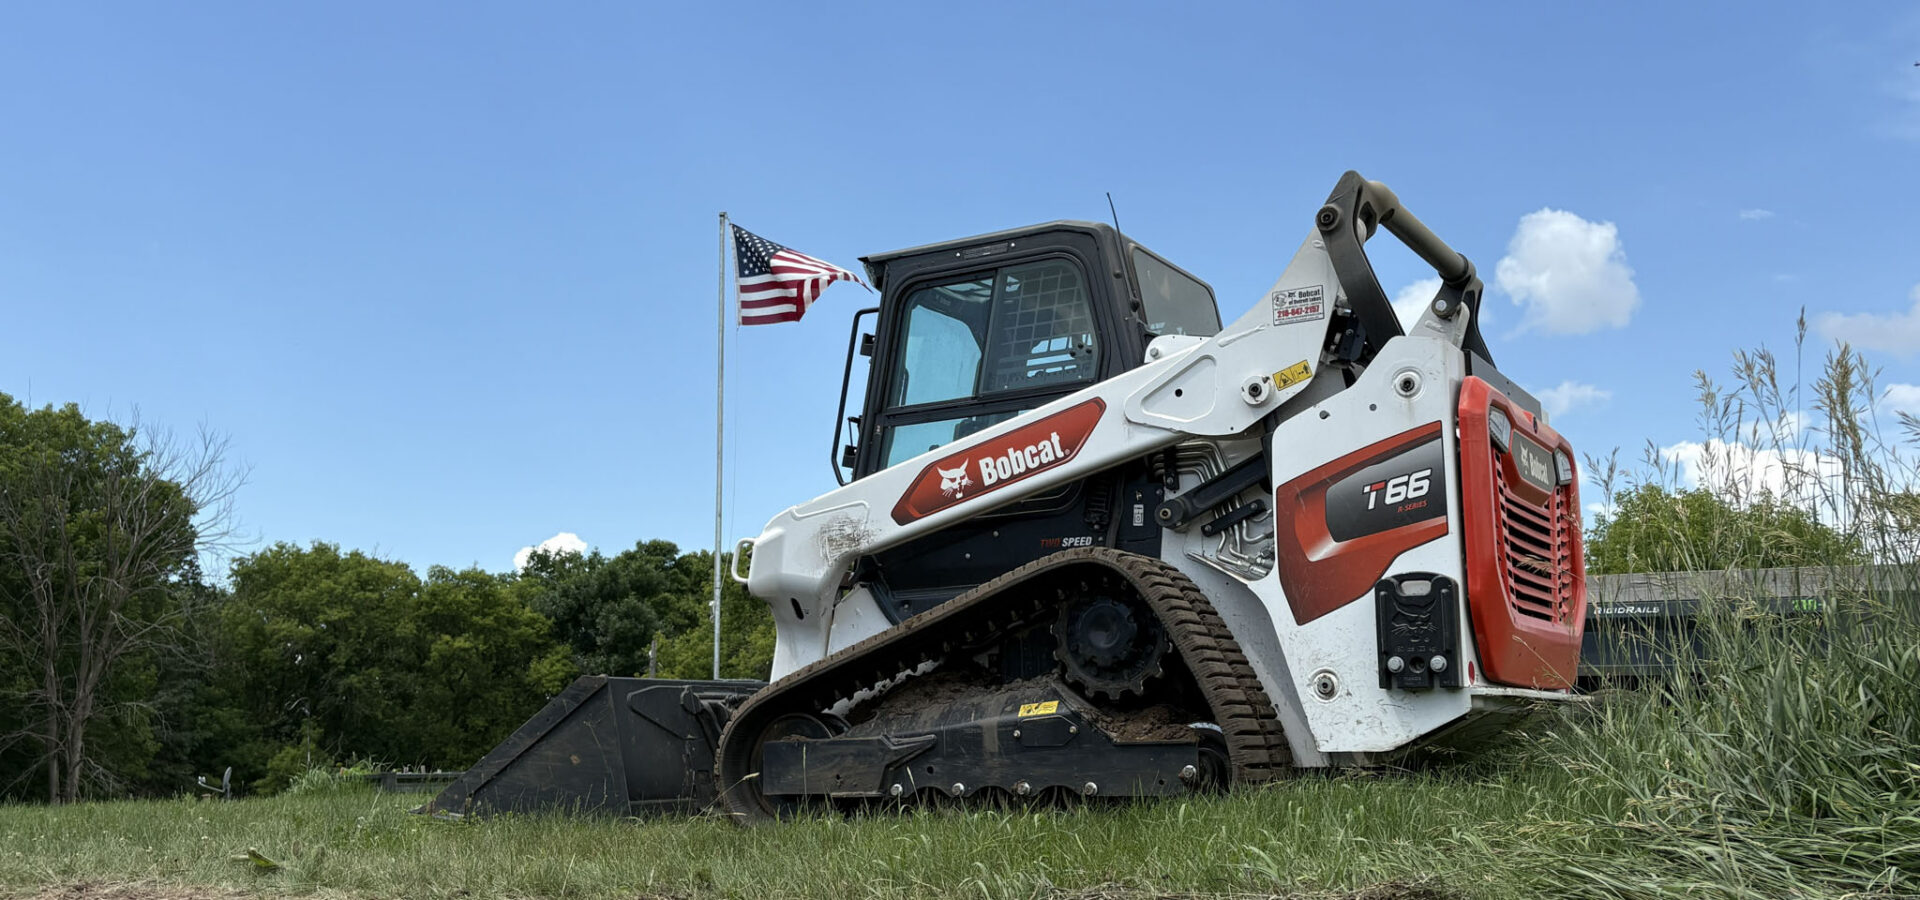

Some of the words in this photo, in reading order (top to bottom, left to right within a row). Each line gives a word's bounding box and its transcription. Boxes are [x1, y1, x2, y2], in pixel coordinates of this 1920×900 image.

[1298, 289, 1320, 298] Bobcat
[979, 431, 1064, 486] Bobcat
[1363, 468, 1432, 510] T66
[1397, 500, 1428, 513] R-SERIES
[1040, 538, 1061, 548] TWO
[1061, 536, 1092, 547] SPEED
